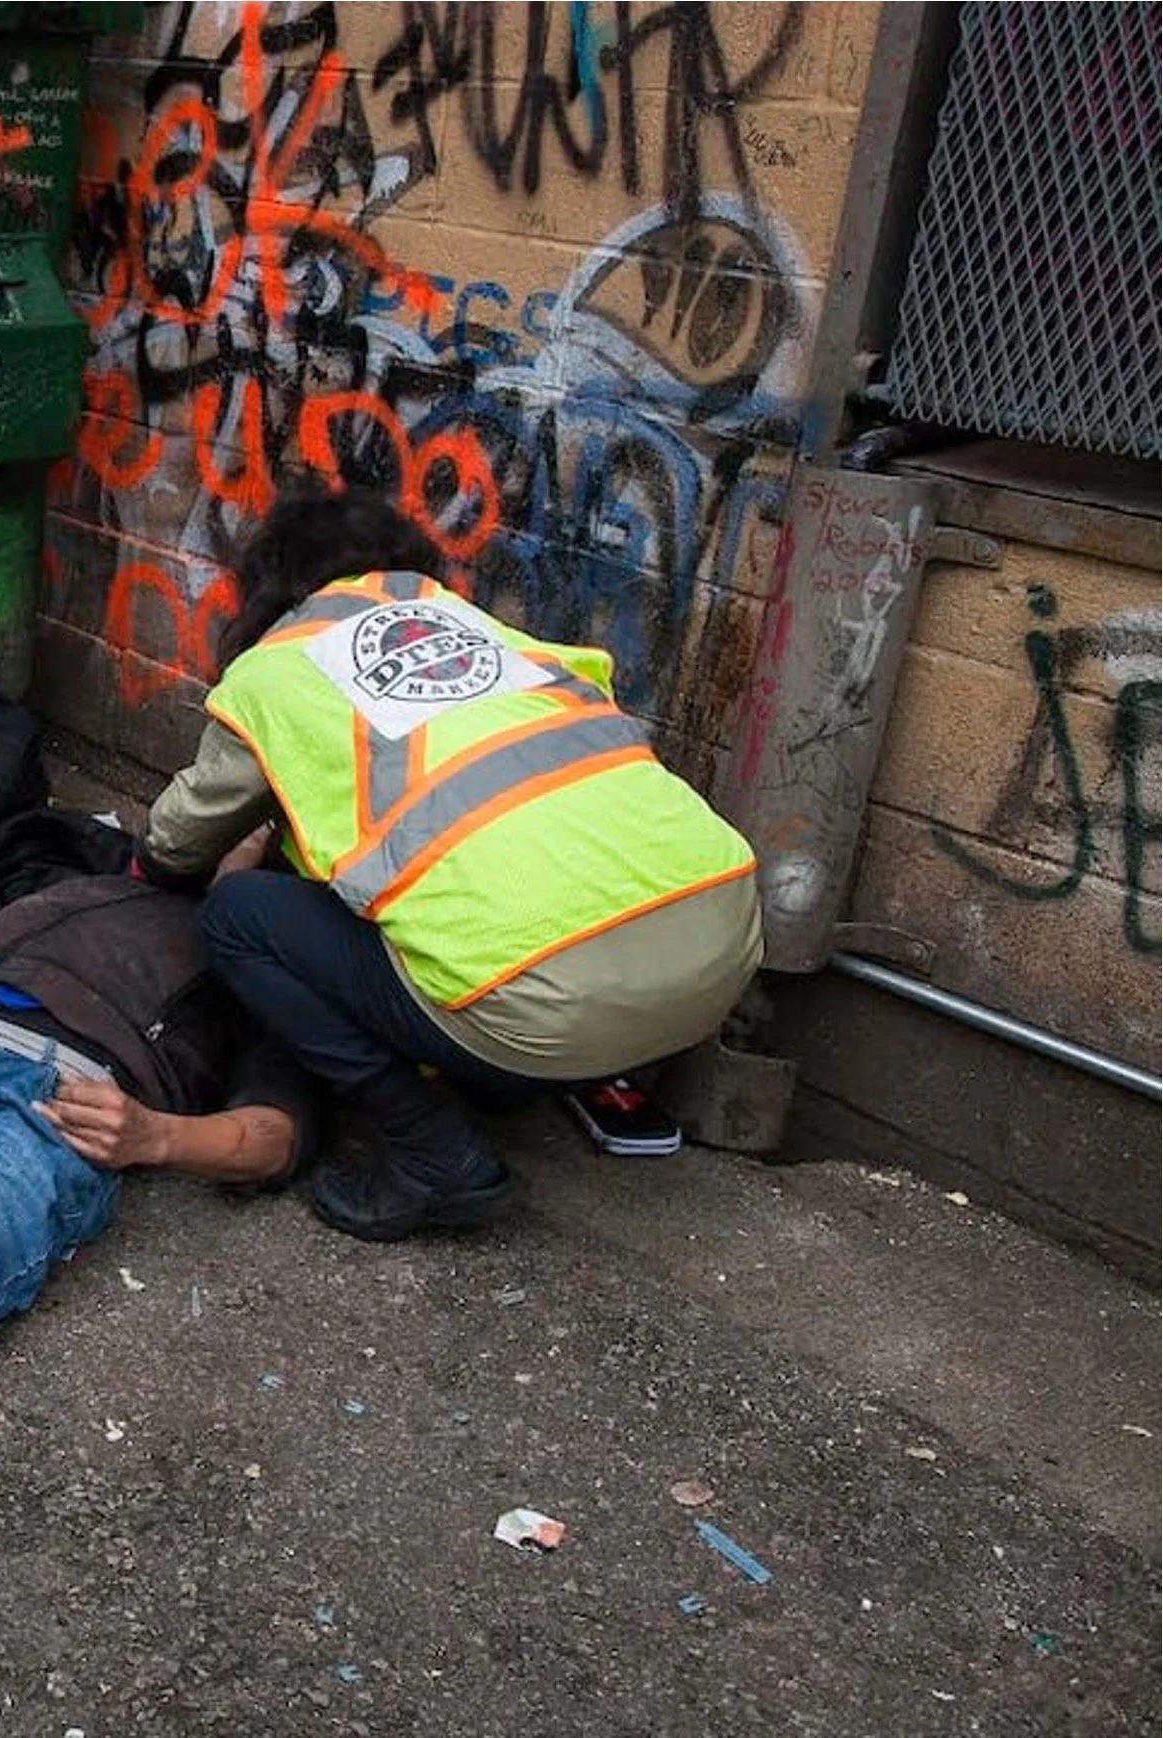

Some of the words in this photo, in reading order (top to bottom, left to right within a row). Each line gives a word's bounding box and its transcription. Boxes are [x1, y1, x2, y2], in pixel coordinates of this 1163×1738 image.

[360, 607, 445, 656] STREET
[365, 628, 489, 693] DTES
[406, 655, 495, 695] MARKET
